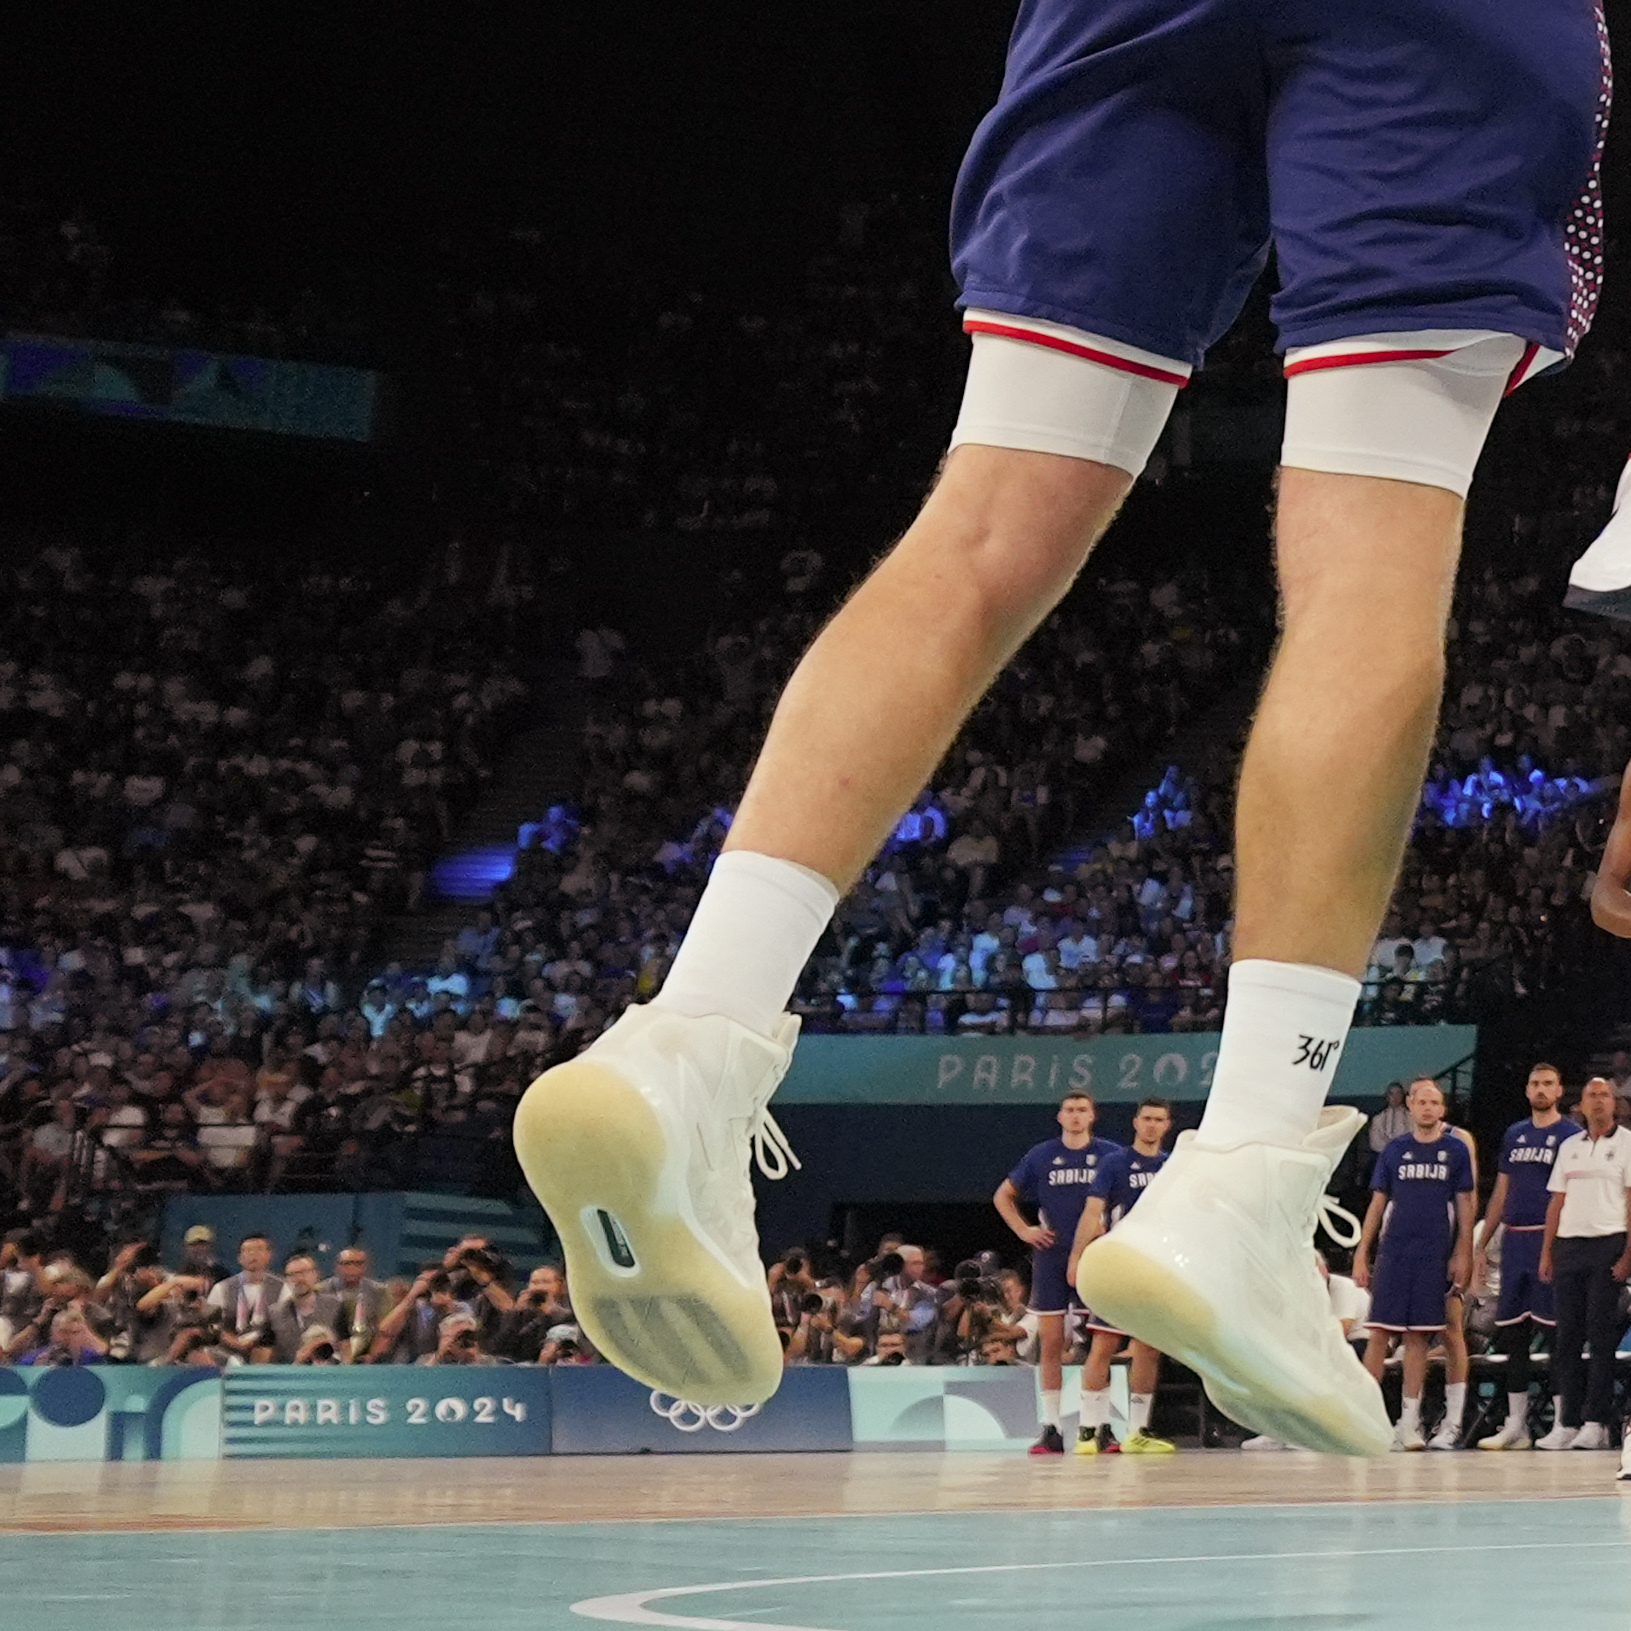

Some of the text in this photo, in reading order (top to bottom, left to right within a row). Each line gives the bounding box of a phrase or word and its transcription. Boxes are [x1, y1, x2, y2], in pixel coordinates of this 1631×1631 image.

[937, 1051, 1219, 1089] PARIS 202
[1398, 1163, 1448, 1180] SRBIJA
[254, 1396, 528, 1426] PARIS 2024
